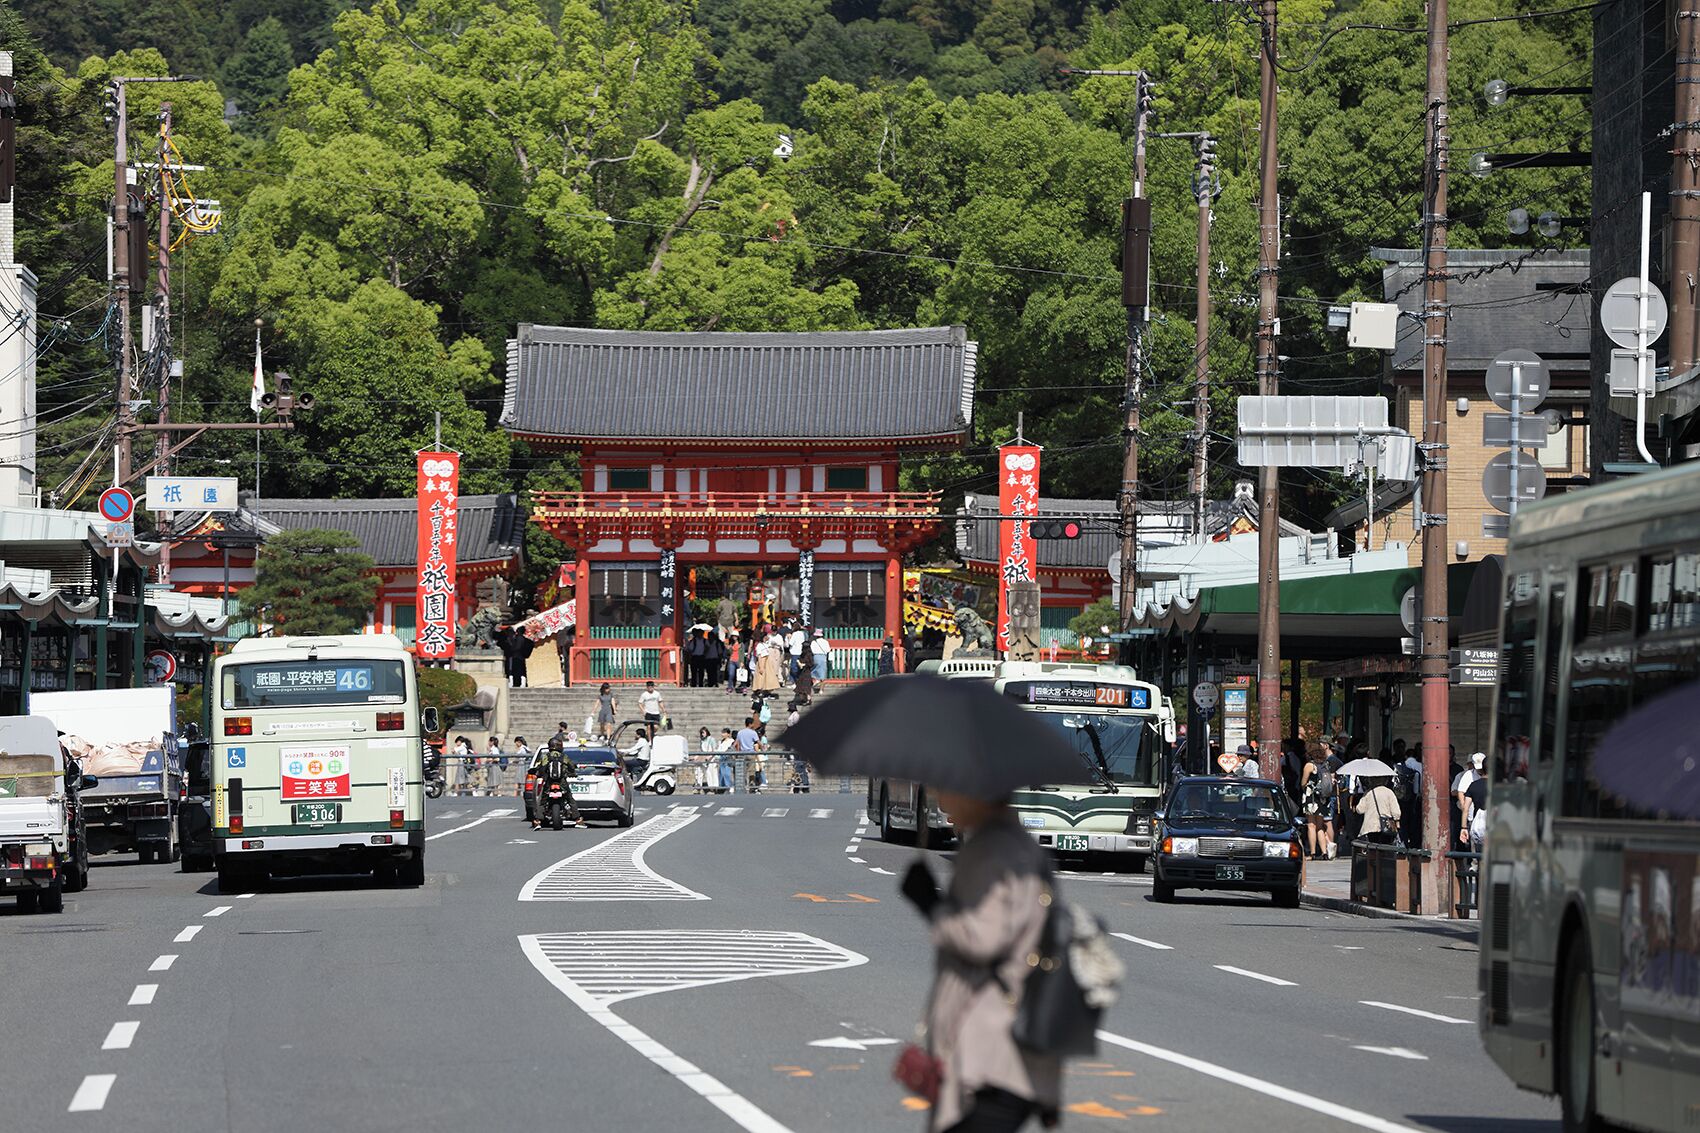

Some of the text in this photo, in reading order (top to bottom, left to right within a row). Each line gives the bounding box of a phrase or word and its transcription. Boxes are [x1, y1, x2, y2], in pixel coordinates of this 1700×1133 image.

[418, 563, 455, 655] 祇園祭
[339, 670, 368, 689] 46
[1472, 669, 1497, 677] 円山公
[1097, 687, 1124, 704] 201
[294, 780, 338, 795] 三笑堂
